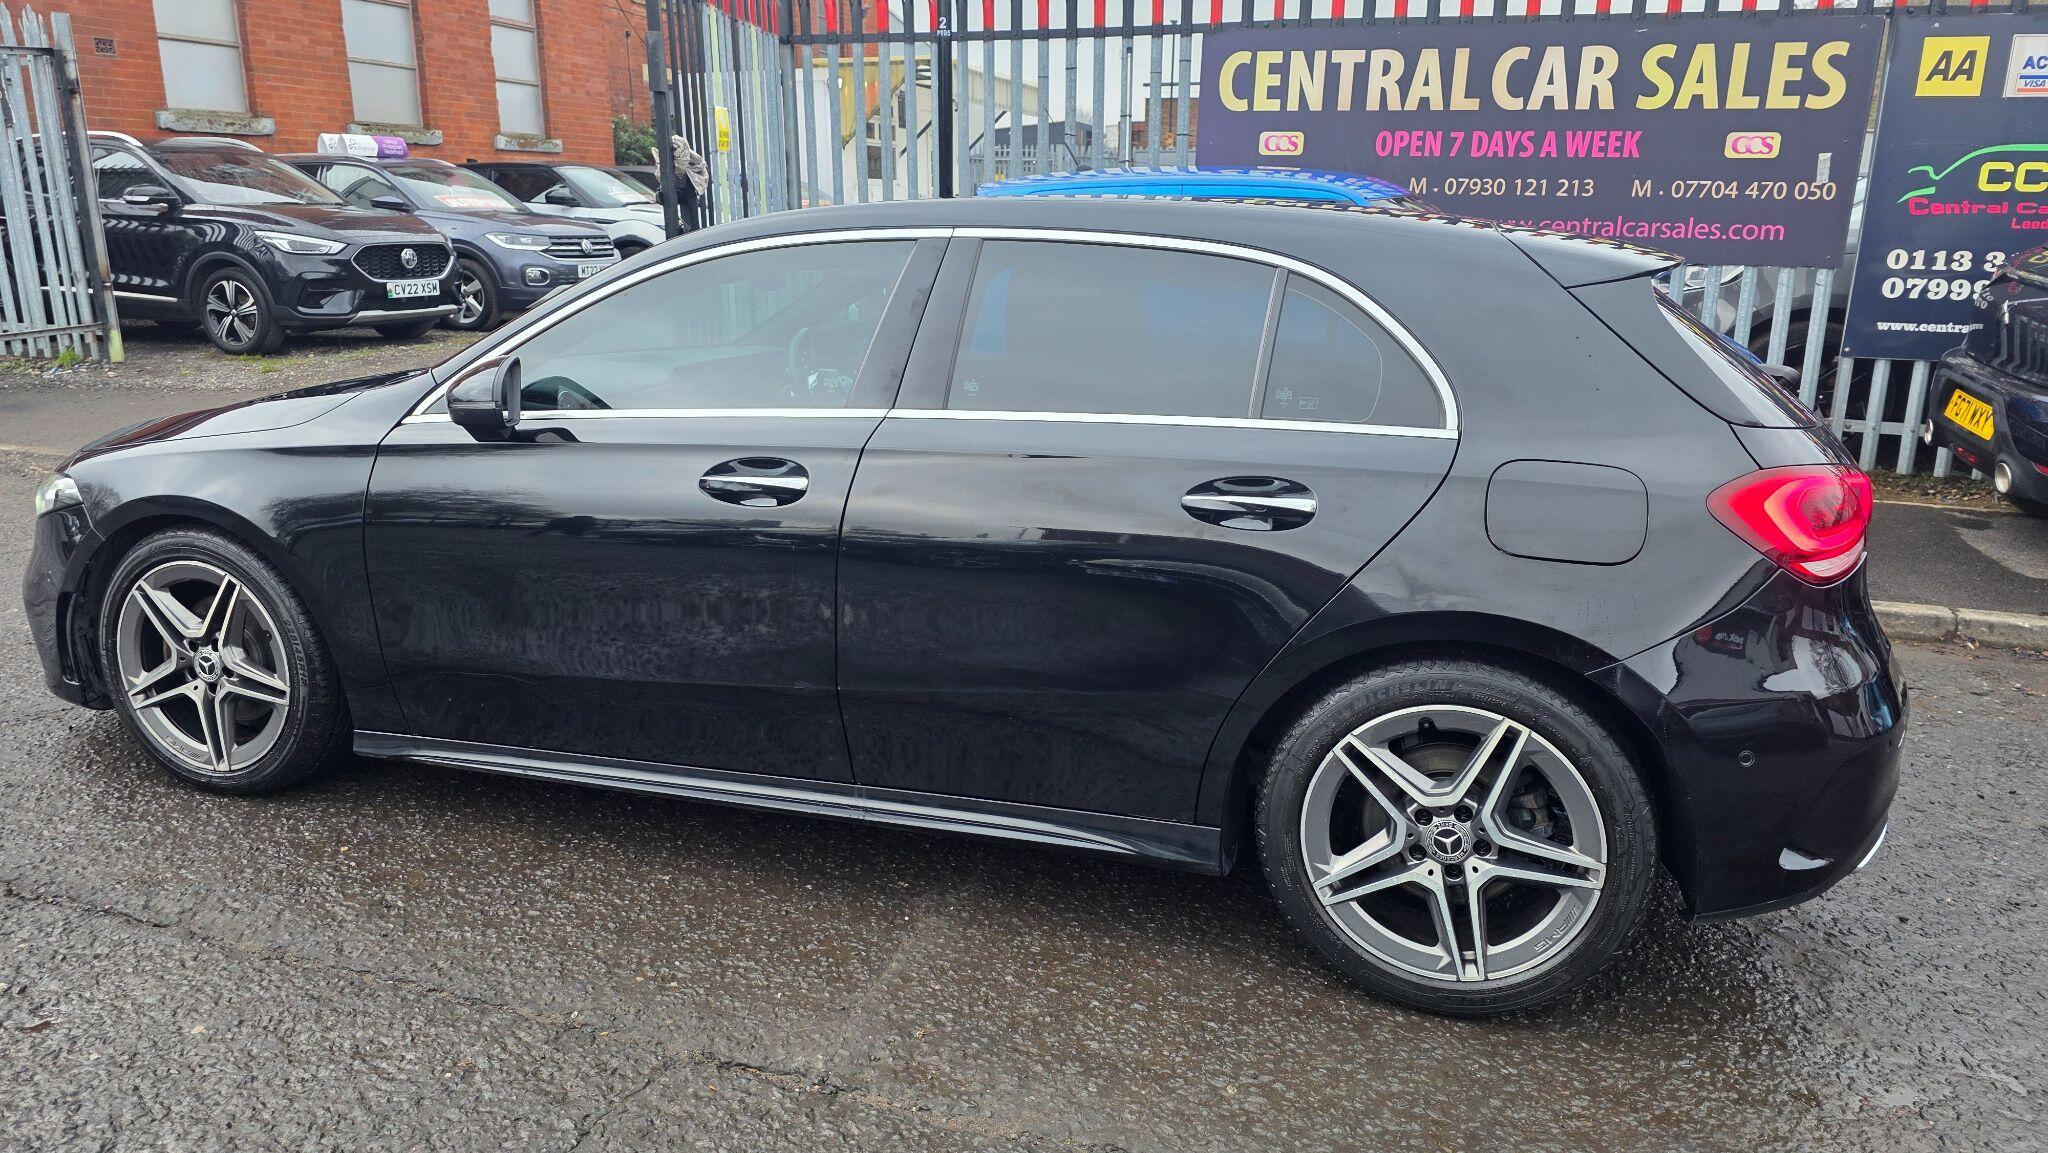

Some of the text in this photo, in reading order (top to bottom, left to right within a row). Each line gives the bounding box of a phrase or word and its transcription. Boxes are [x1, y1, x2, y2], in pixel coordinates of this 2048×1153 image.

[939, 16, 947, 29] 2
[1924, 50, 1978, 81] AA
[1218, 41, 1850, 112] CENTRAL CAR SALES
[1375, 130, 1643, 158] OPEN 7 DAYS A WEEK
[1444, 177, 1506, 196] 07930
[1514, 179, 1547, 196] 121
[1556, 179, 1594, 197] 213
[1671, 180, 1739, 199] 07704
[1745, 181, 1787, 200] 470
[1794, 181, 1837, 200] 050
[1908, 197, 2009, 215] Central
[1886, 248, 1973, 272] 0113
[394, 282, 438, 295] CV22 XSM
